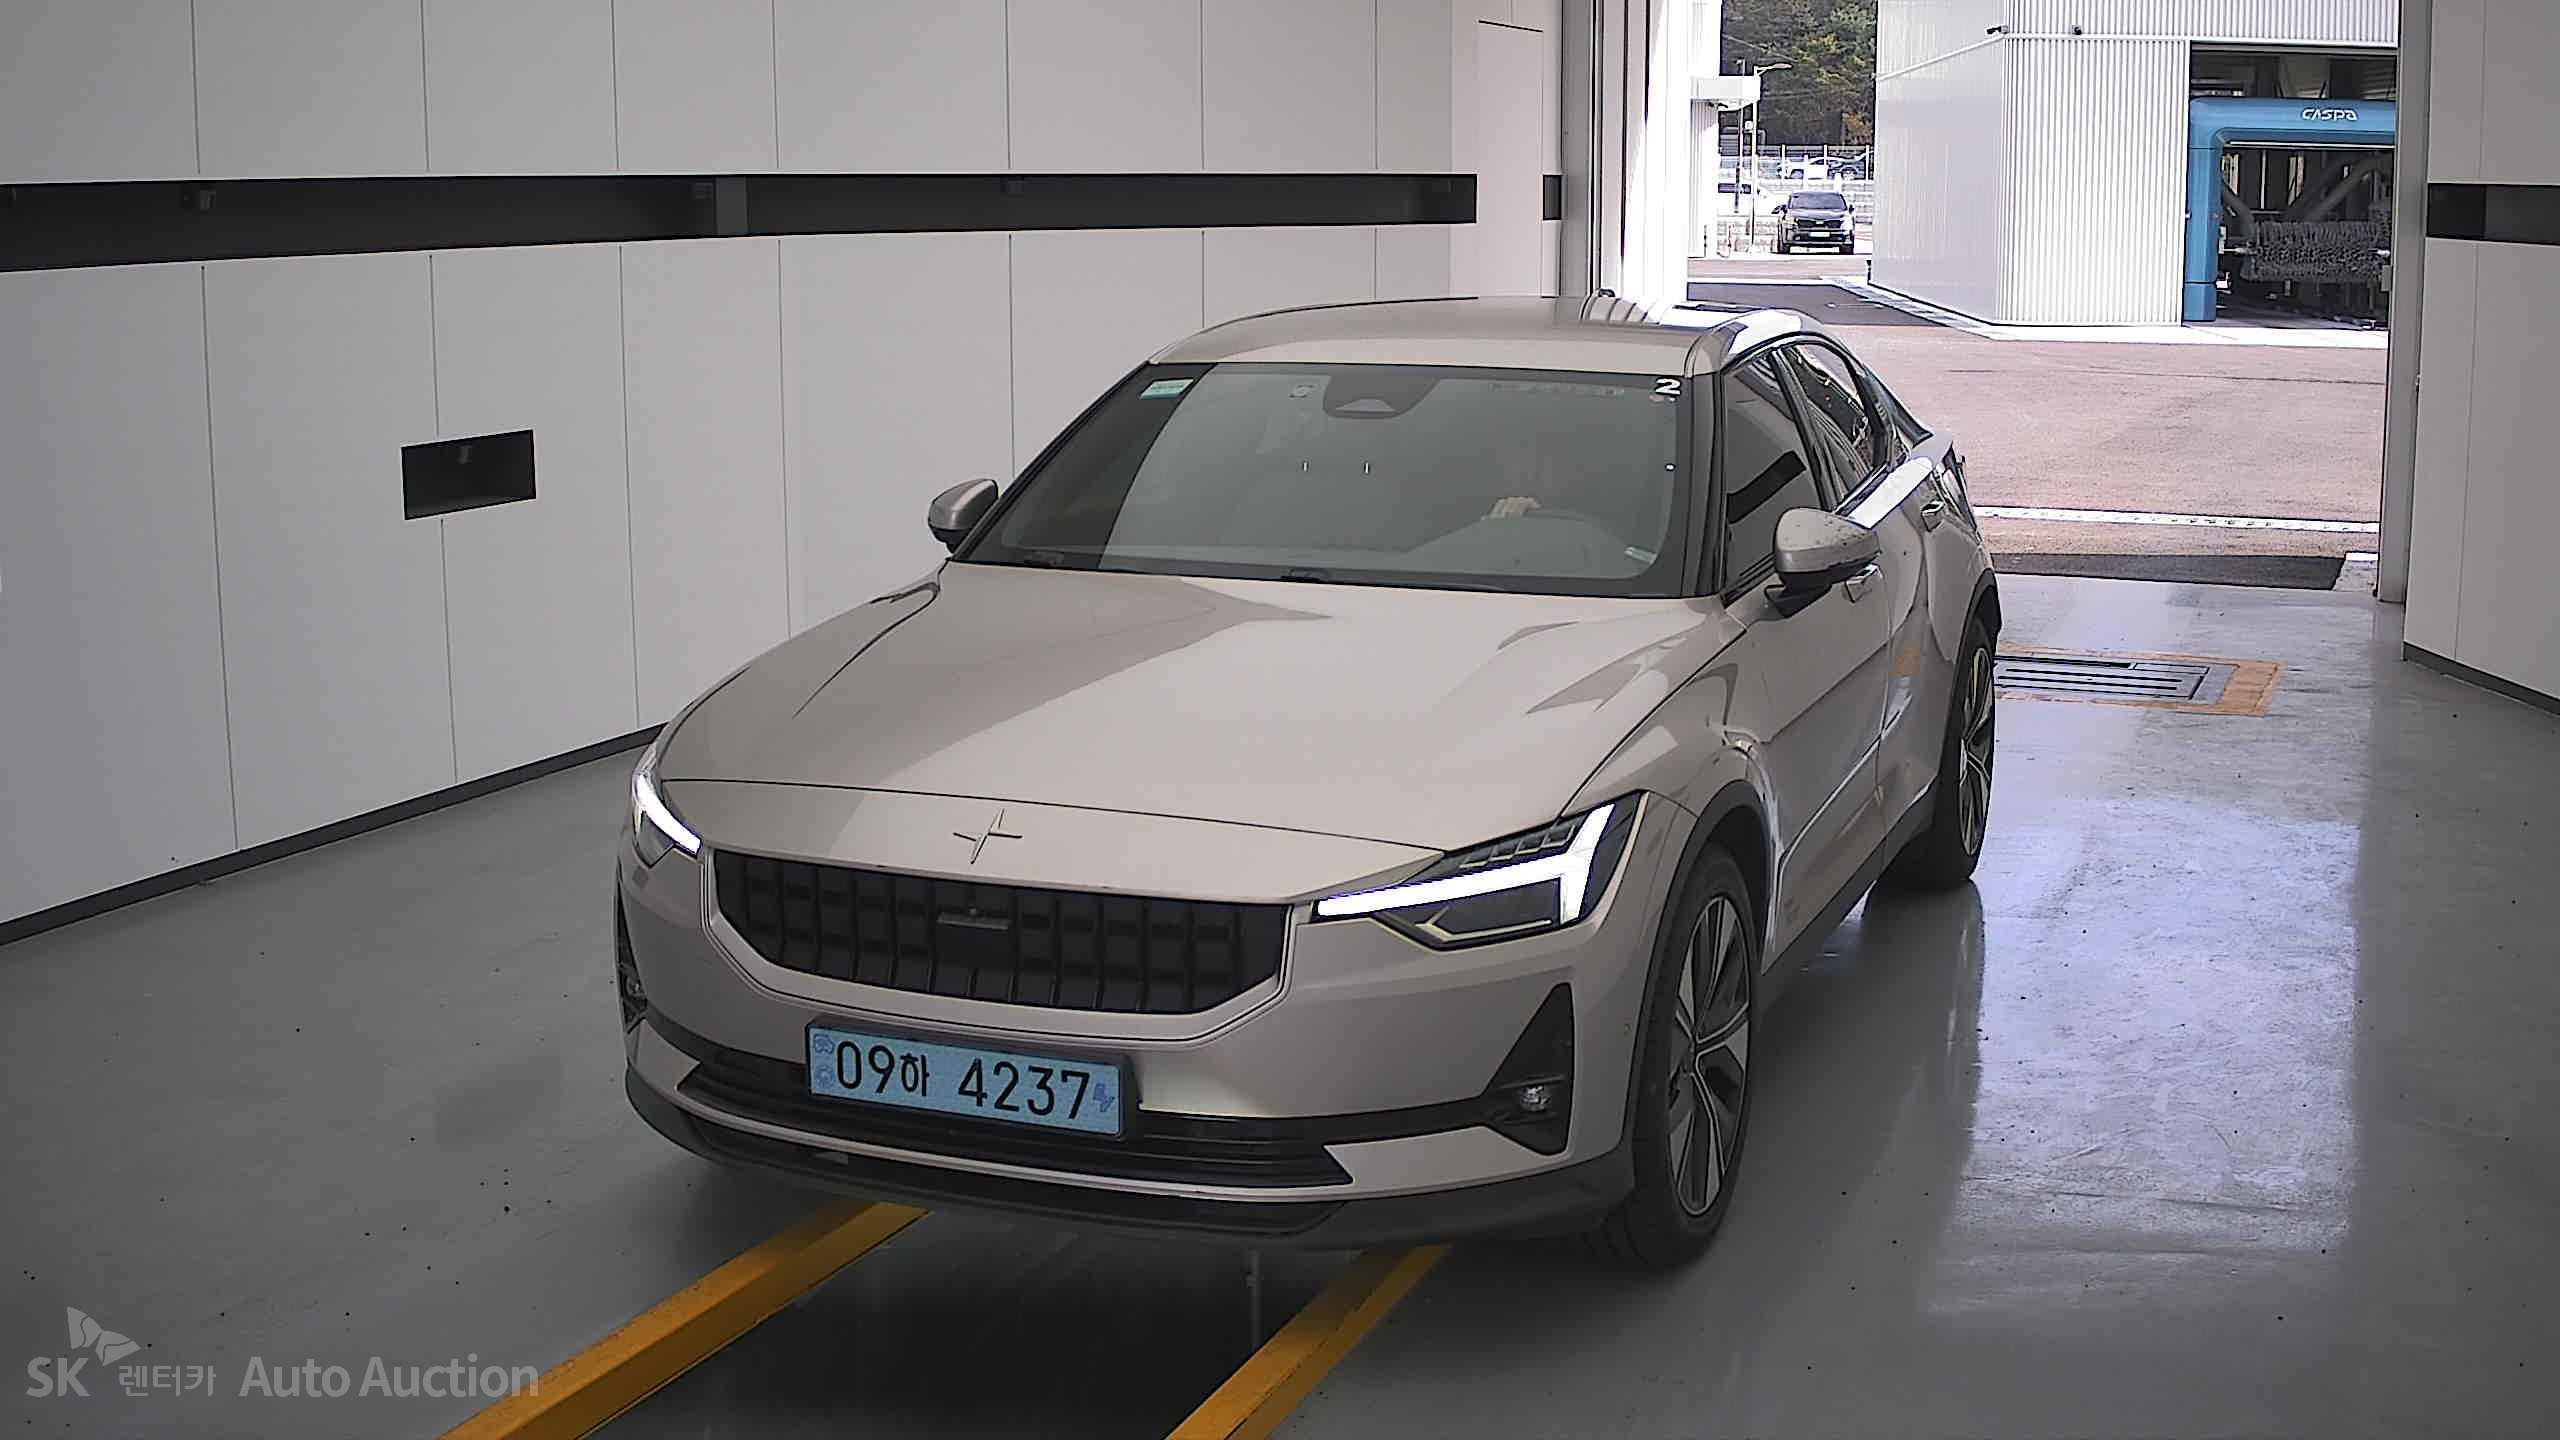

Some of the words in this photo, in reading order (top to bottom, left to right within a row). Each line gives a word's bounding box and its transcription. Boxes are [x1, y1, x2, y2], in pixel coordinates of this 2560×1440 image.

[1655, 378, 1681, 395] 2
[836, 1040, 929, 1097] 09하
[958, 1057, 1090, 1119] 4237
